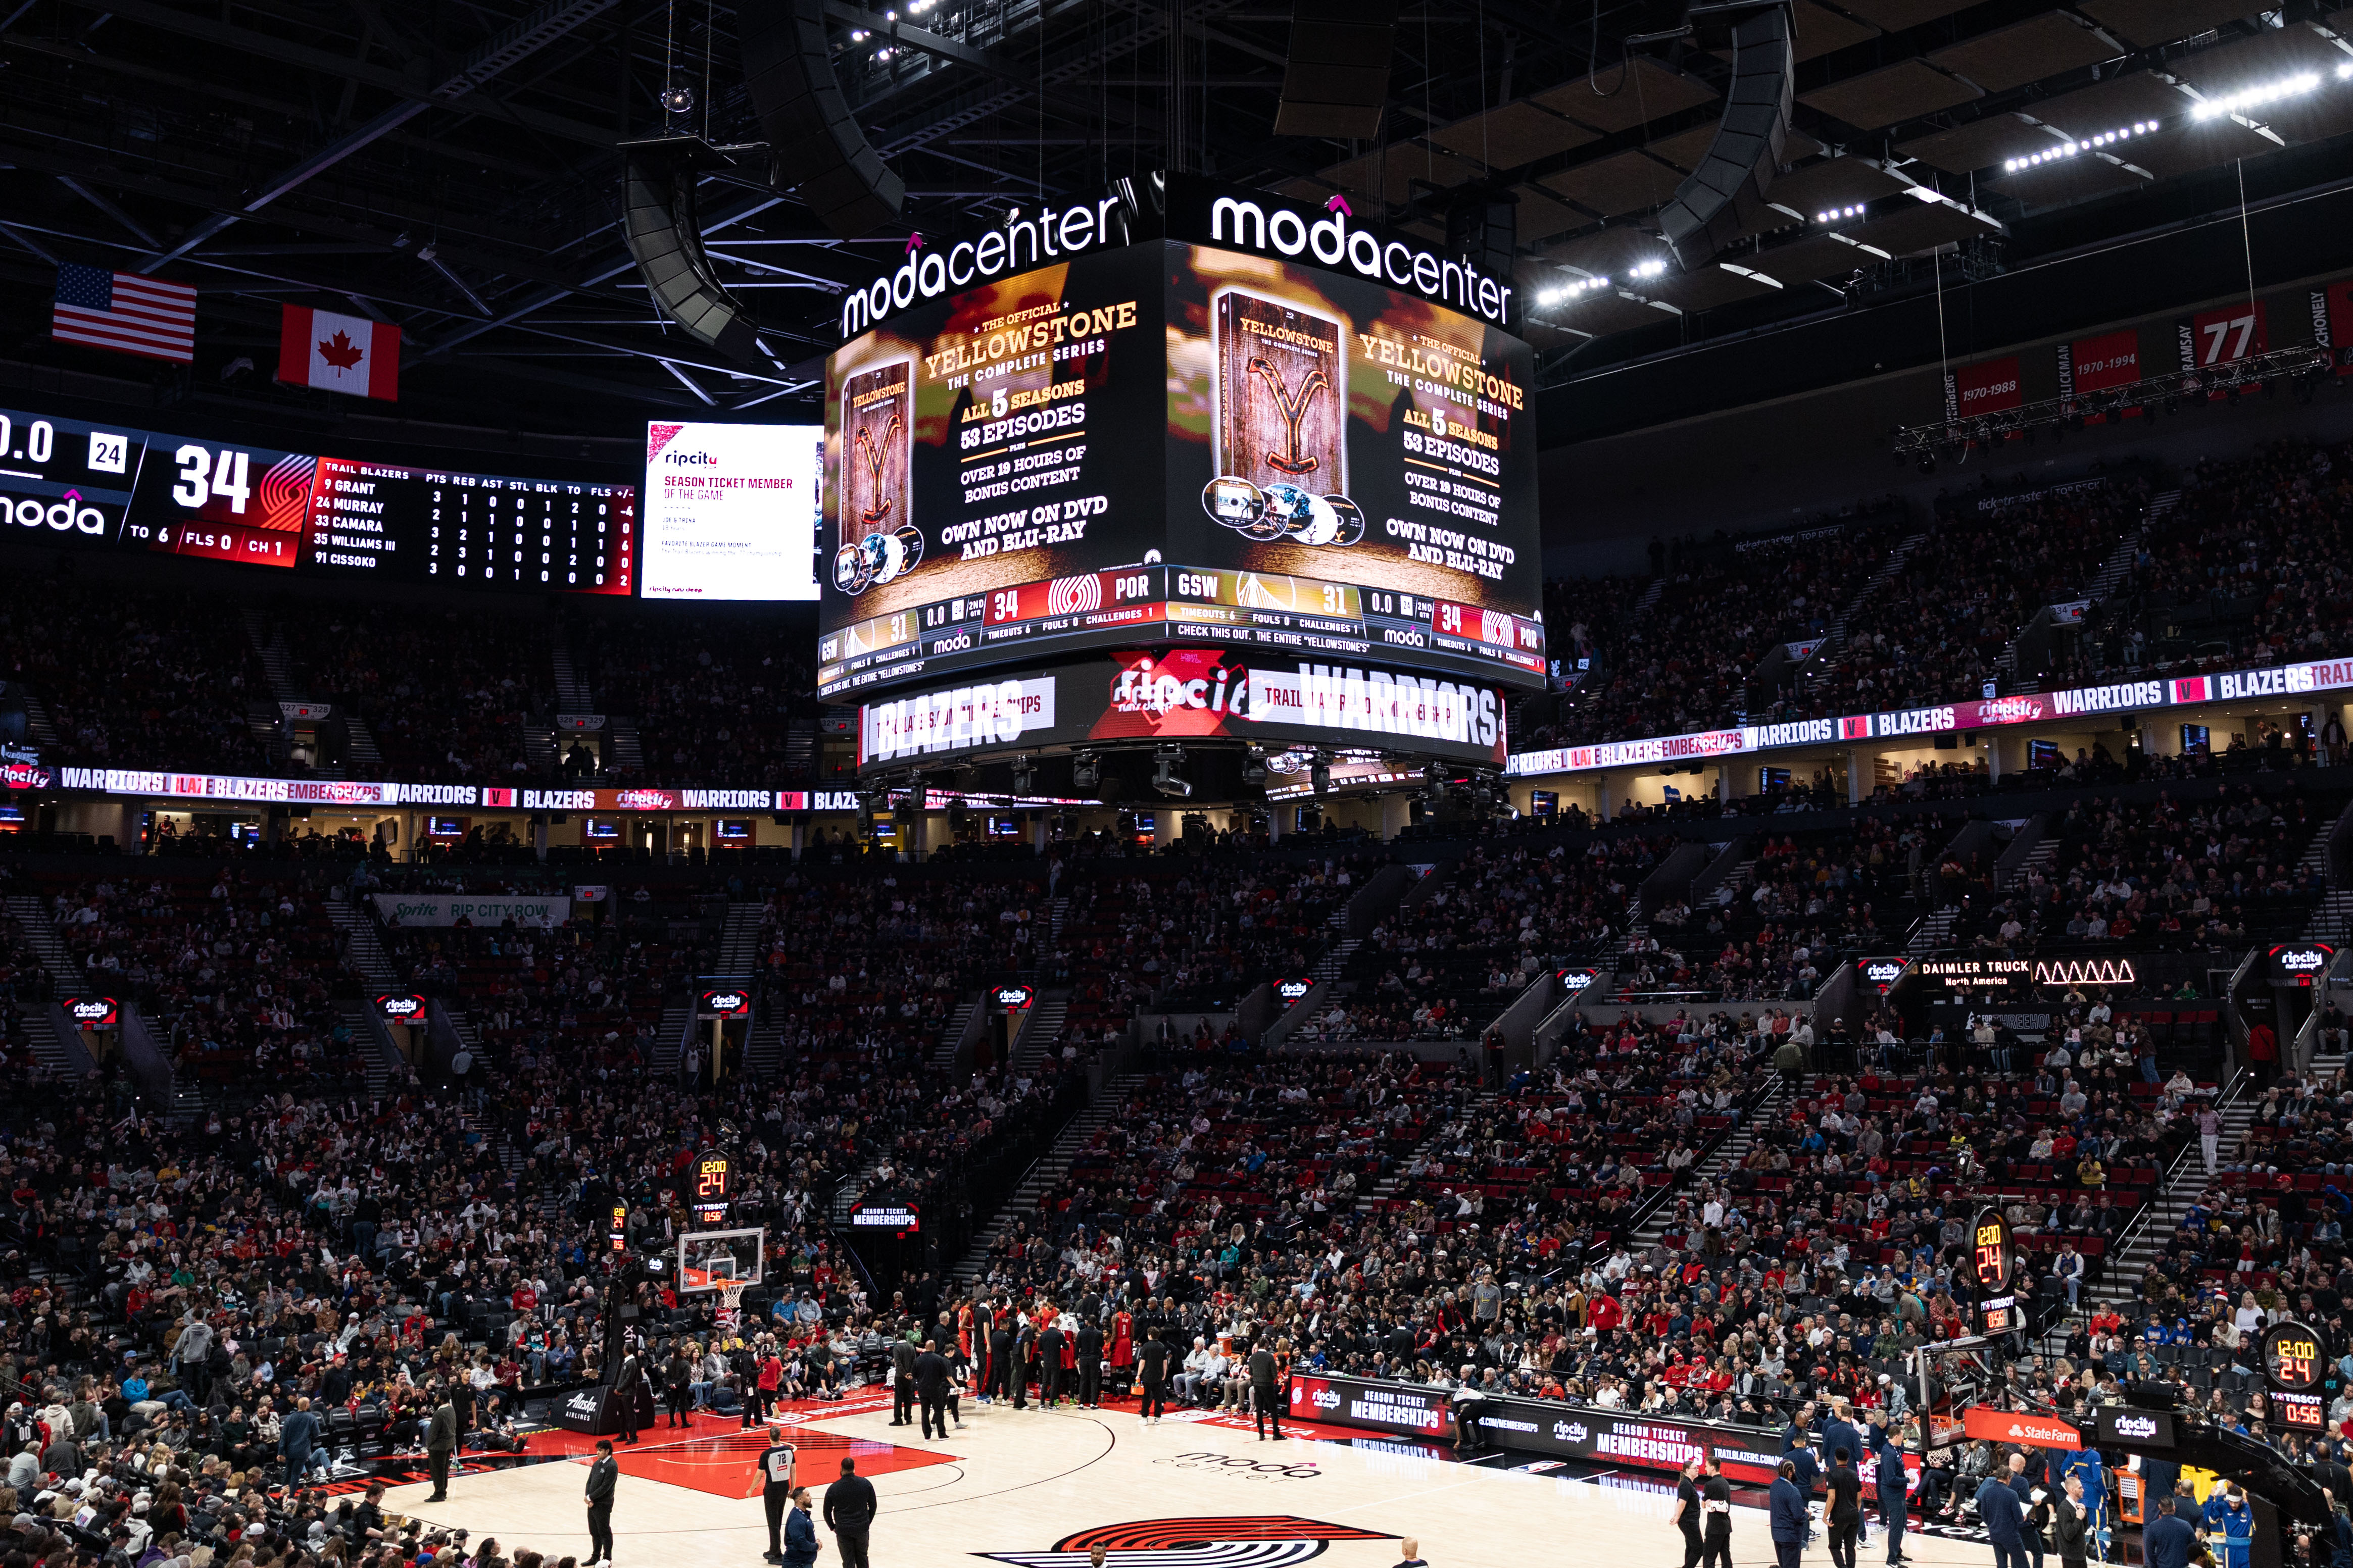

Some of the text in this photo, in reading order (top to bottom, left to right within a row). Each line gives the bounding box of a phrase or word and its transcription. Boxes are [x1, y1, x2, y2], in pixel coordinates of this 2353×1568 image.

[982, 302, 1060, 332] THE OFFICIAL
[925, 301, 1136, 379] YELLOWSTONE
[1240, 317, 1333, 353] YELLOWSTONE
[2203, 315, 2253, 364] 77
[2179, 325, 2194, 371] RAMSAY
[948, 339, 1104, 390] THE COMPLETE SERIES
[2078, 354, 2135, 375] 1970-1994
[962, 379, 1085, 423] ALL 5 SEASONS
[1963, 381, 2016, 401] 1970-1988
[961, 403, 1085, 449] 53 EPISODES
[95, 442, 120, 465] 24
[666, 450, 717, 469] ripcity
[961, 446, 1086, 485] OVER 19 HOURS OF
[173, 444, 250, 514] 34
[324, 478, 375, 495] 9 GRANT
[326, 463, 611, 496] TRAIL BLAZERS PTS REB AST STL BLK TO FLS
[665, 476, 792, 489] SEASON TICKET MEMBER
[965, 467, 1080, 503] BONUS CONTENT
[316, 496, 383, 514] 24 MURRAY
[664, 489, 723, 500] OF THE GAME
[315, 515, 383, 532] 33 CAMARA
[942, 496, 1107, 545] OWN NOW ON DVD
[130, 525, 281, 555] TO 6 FLS 0 CH 1
[314, 533, 395, 550] 35 WILLIAMS III
[961, 521, 1086, 561] AND BLU-RAY
[316, 552, 375, 568] 91 CISSOKO
[1179, 574, 1347, 614] GSW 31
[1372, 592, 1392, 614] 0.0
[1385, 628, 1424, 646] moda
[1442, 604, 1537, 649] 34 POR
[934, 632, 970, 654] moda
[1178, 625, 1369, 653] CHECK THIS OUT. THE ENTIRE "YELLOWSTONE'S"
[2221, 666, 2315, 699] BLAZERS
[1300, 665, 1495, 746] WARRIORS
[2053, 681, 2161, 714] WARRIORS
[878, 680, 1022, 762] BLAZERS
[1880, 707, 1954, 736] BLAZERS
[1743, 719, 1831, 748] WARRIORS
[1601, 741, 1663, 767] BLAZERS
[62, 767, 163, 792] WARRIORS
[214, 778, 288, 801] BLAZERS
[383, 783, 476, 805] WARRIORS
[523, 791, 595, 809] BLAZERS
[682, 790, 770, 808] WARRIORS
[396, 903, 438, 919] Sprite
[451, 904, 549, 917] RIP CITY ROW
[1923, 960, 2029, 974] DAIMLER TRUCK
[2282, 950, 2322, 966] ripcity
[1280, 983, 1307, 995] ripcity
[1946, 977, 2007, 986] North America
[386, 999, 417, 1011] ripcity
[711, 995, 741, 1007] ripcity
[999, 989, 1026, 1003] ripcity
[74, 1002, 108, 1015] ripcity
[702, 1161, 726, 1173] 12:00
[699, 1173, 724, 1195] 24
[614, 1208, 625, 1217] 12:00
[614, 1217, 623, 1228] 24
[704, 1212, 721, 1222] 0:56
[854, 1214, 915, 1226] MEMBERSHIPS
[613, 1240, 623, 1249] 0:56
[1978, 1224, 2001, 1246] 12:00
[1976, 1246, 2002, 1283] 24
[1987, 1310, 2003, 1328] 0:56
[2278, 1340, 2314, 1359] 12:00
[2280, 1357, 2311, 1382] 24
[568, 1393, 597, 1412] Alaska
[1311, 1389, 1340, 1407] ripcity
[1364, 1390, 1425, 1407] SEASON TICKET
[565, 1411, 590, 1421] AIRLINES
[1351, 1400, 1438, 1429] MEMBERSHIPS
[2286, 1403, 2320, 1424] 0:56
[1553, 1420, 1587, 1441] ripcity
[1612, 1423, 1687, 1443] SEASON TICKET
[777, 1453, 786, 1464] 72
[1597, 1433, 1703, 1466] MEMBERSHIPS
[1152, 1458, 1295, 1484] center
[1174, 1452, 1322, 1480] moda
